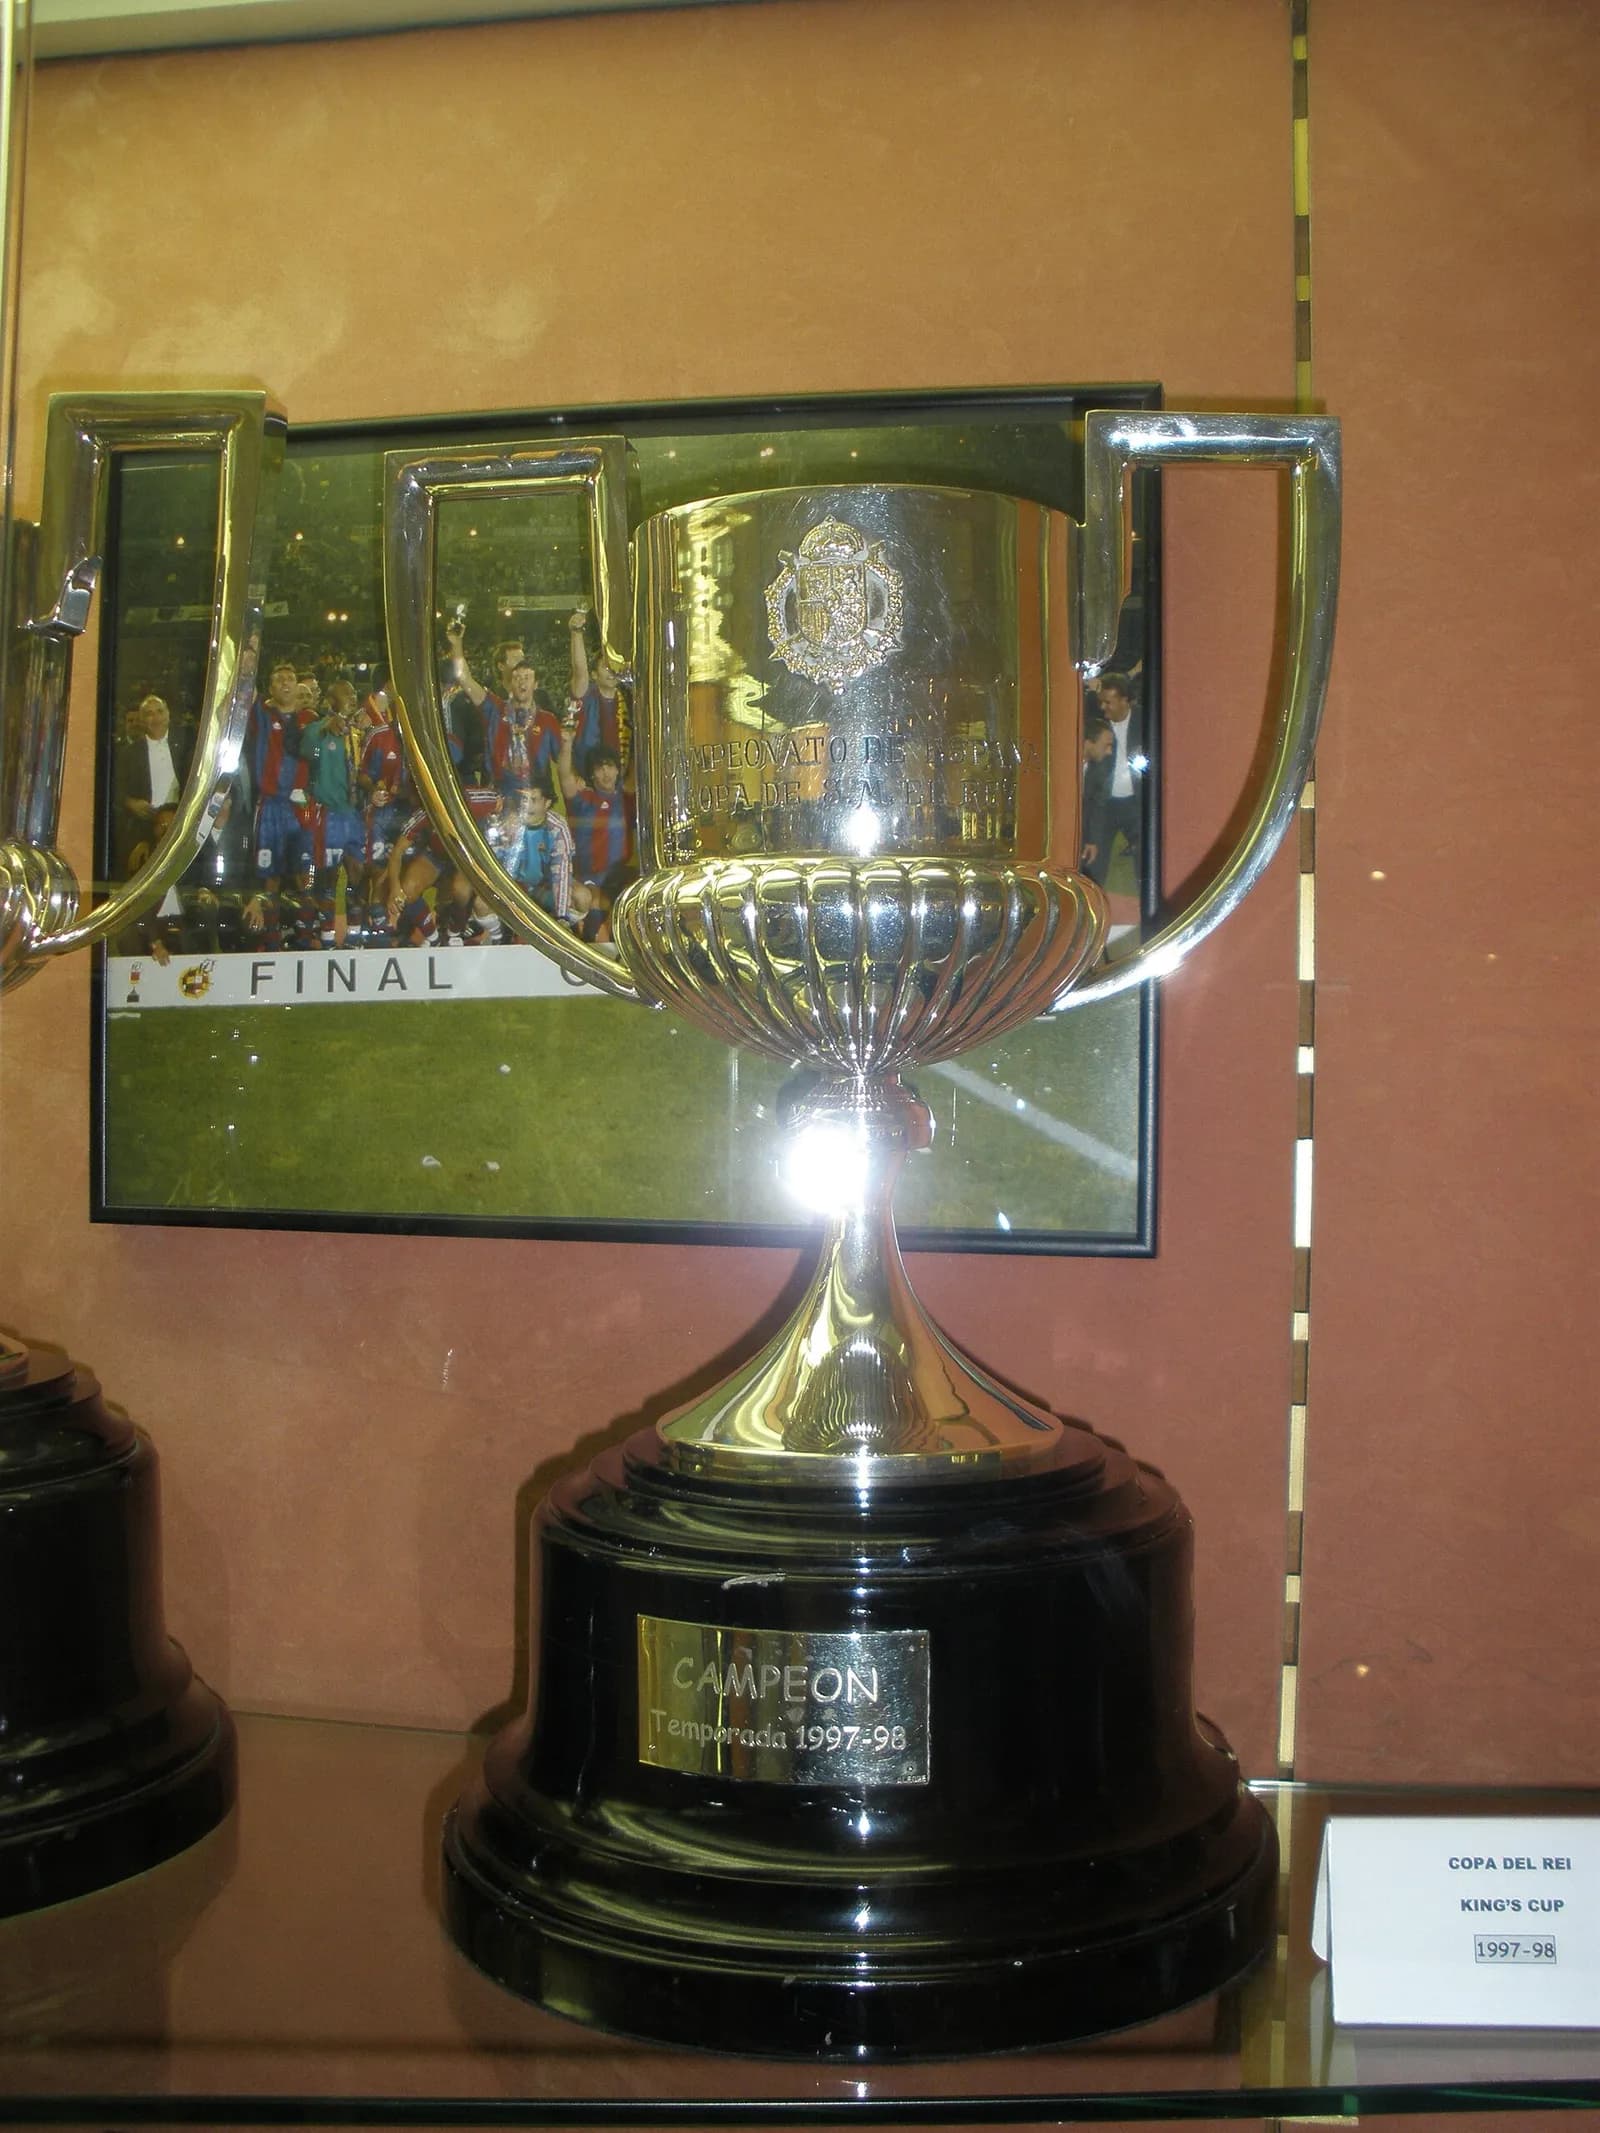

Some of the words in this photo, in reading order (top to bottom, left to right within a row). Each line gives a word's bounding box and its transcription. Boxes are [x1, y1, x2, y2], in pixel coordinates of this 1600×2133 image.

[761, 780, 801, 810] DE
[251, 956, 453, 996] FINAL
[672, 1657, 879, 1704] CAMPEON
[650, 1708, 788, 1750] Temporada
[795, 1724, 907, 1752] 1997-98
[1448, 1857, 1497, 1871] COPA
[1503, 1857, 1537, 1871] DEL
[1542, 1857, 1572, 1871] REI
[1460, 1899, 1522, 1913] KING'S
[1528, 1899, 1565, 1913] CUP
[1476, 1941, 1555, 1959] 1997-98
